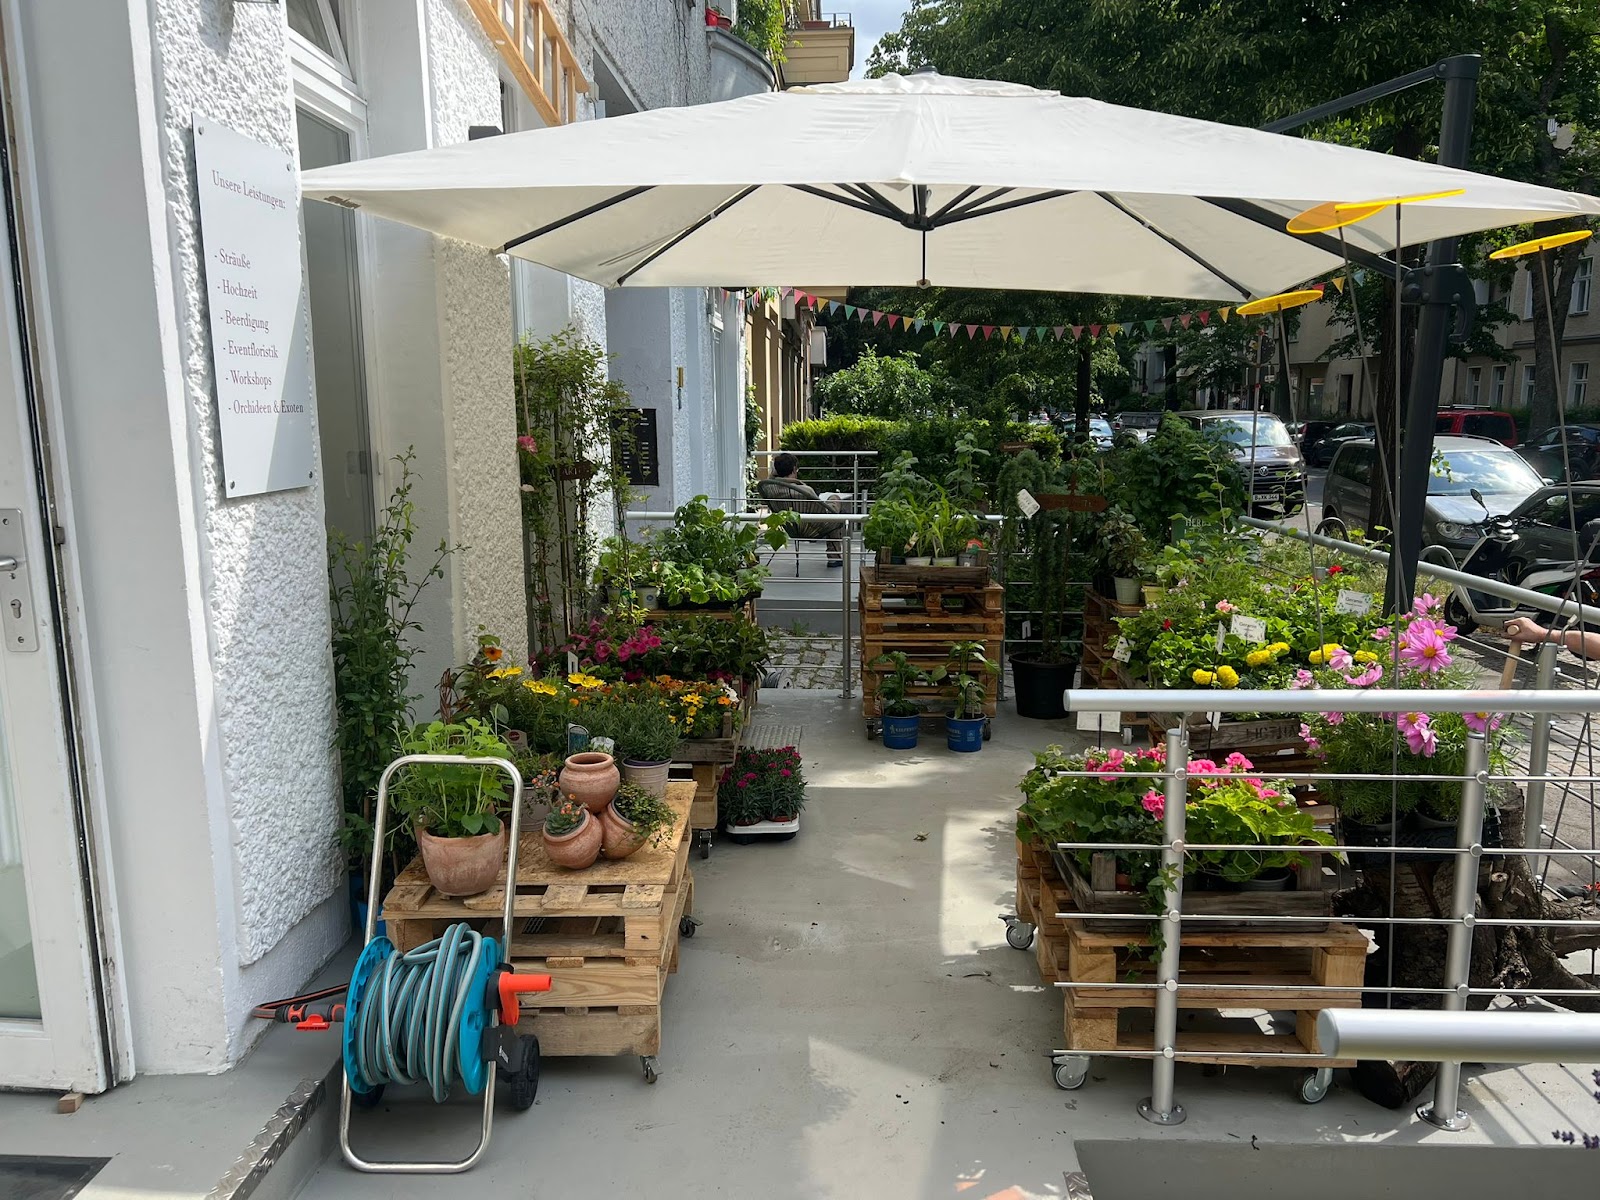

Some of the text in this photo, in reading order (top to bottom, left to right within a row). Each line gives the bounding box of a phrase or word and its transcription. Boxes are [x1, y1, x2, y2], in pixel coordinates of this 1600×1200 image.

[212, 169, 286, 210] Unsere Leistungen:
[219, 248, 251, 269] Sträuße
[222, 278, 258, 299] Hochzeit
[225, 309, 270, 334] Beerdigung
[228, 340, 279, 359] Eventfloristik
[230, 369, 272, 390] Workshops
[233, 399, 272, 414] Orchideen
[273, 400, 280, 414] &
[281, 399, 304, 414] Exoten
